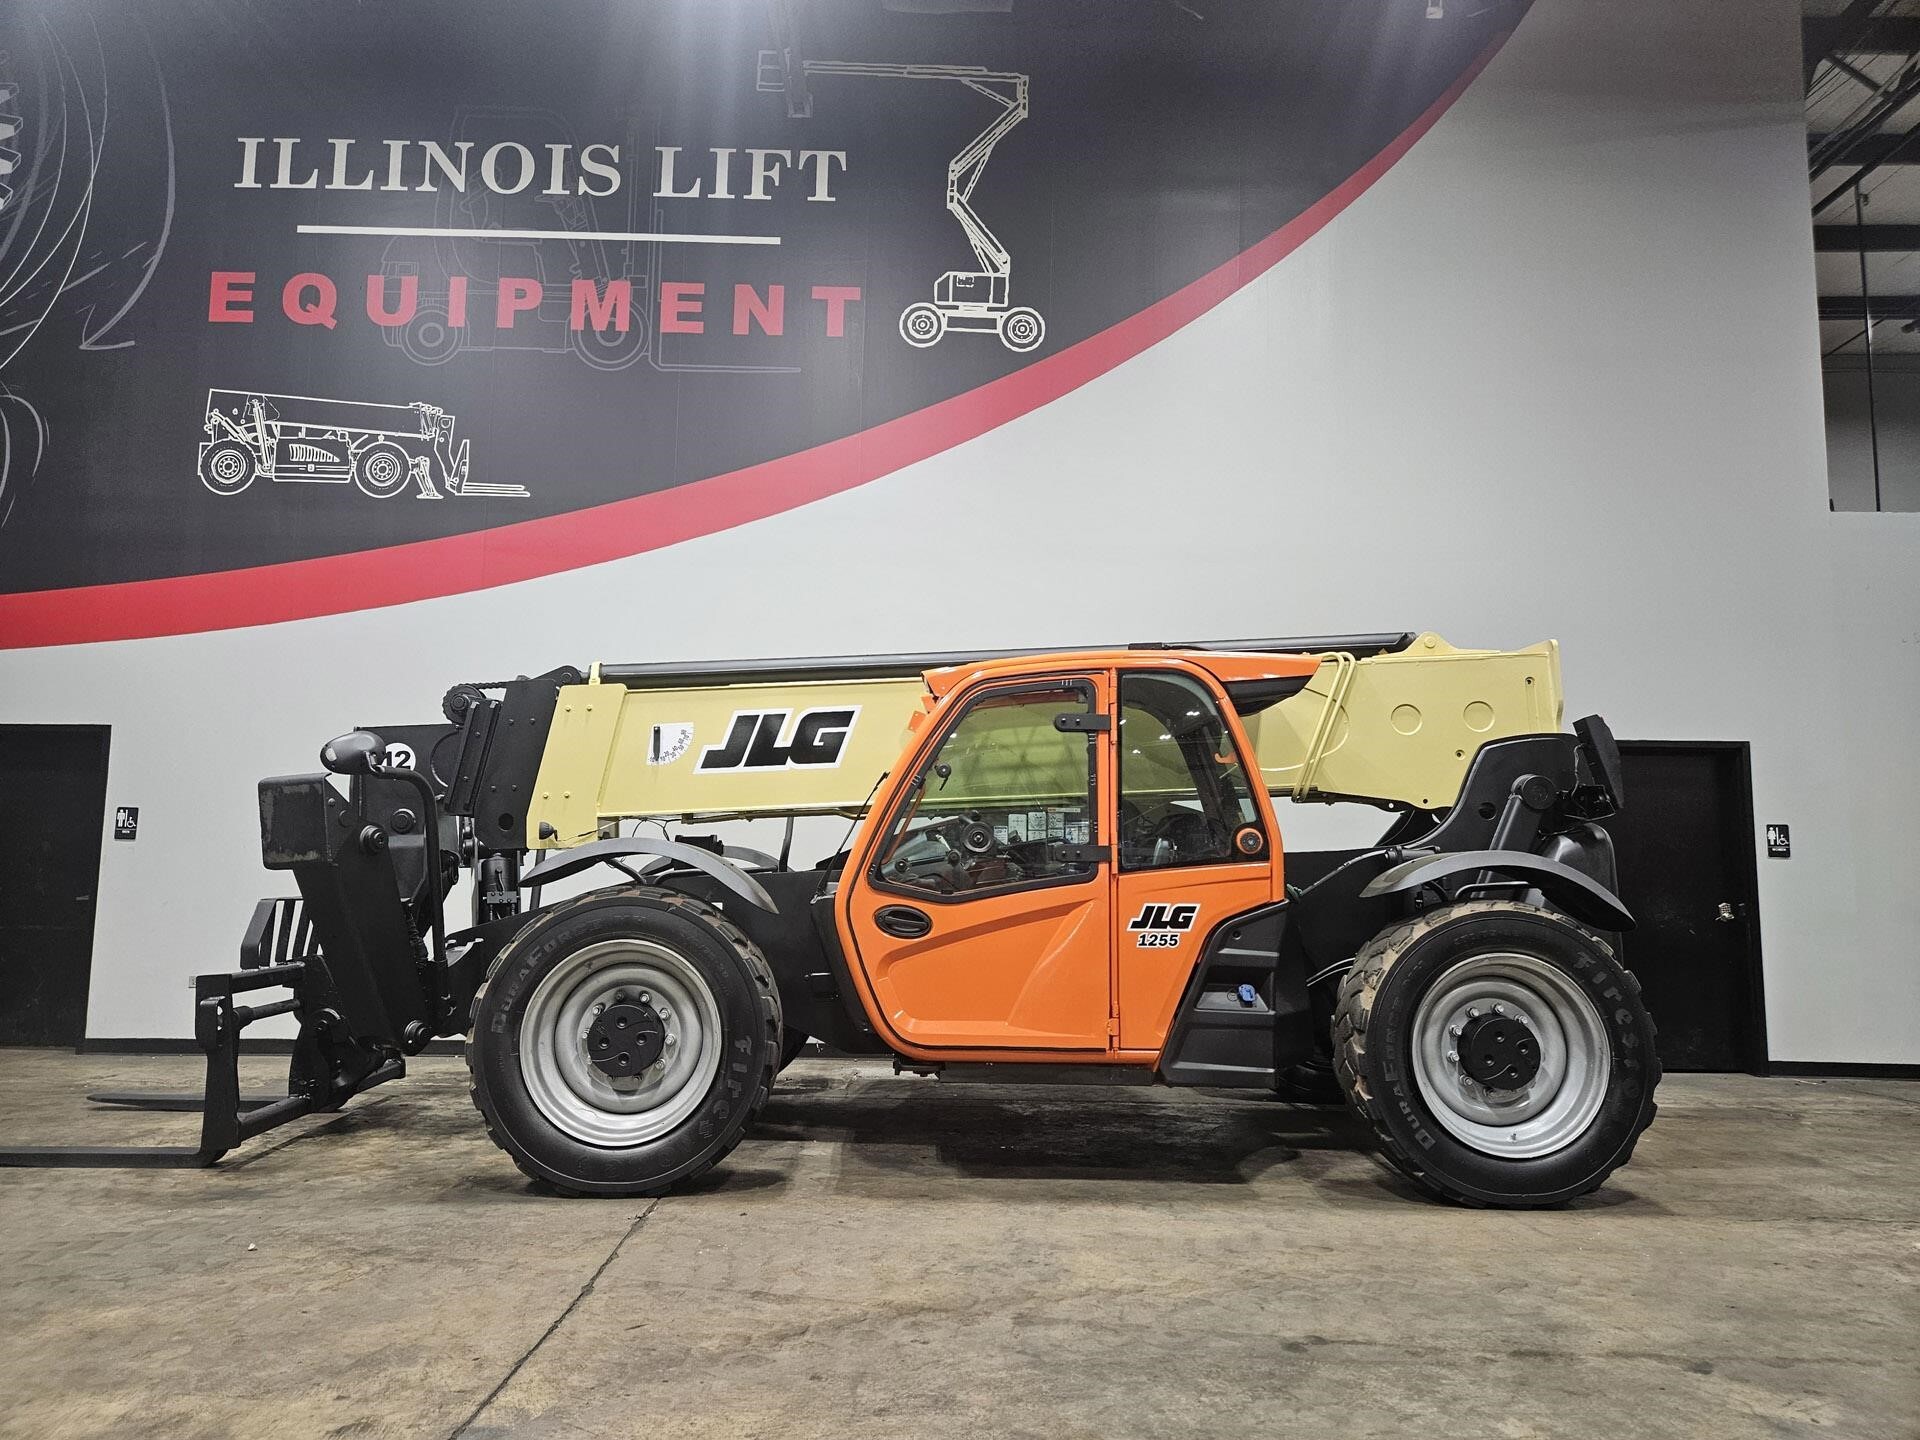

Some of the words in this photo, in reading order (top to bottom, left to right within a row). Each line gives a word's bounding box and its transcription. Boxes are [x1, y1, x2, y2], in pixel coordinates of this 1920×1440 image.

[234, 137, 622, 197] ILLINOIS
[652, 146, 848, 203] LIFT
[208, 271, 861, 338] EQUIPMENT
[700, 710, 856, 769] JLG
[1129, 905, 1197, 930] JLG
[1138, 933, 1179, 947] 1255
